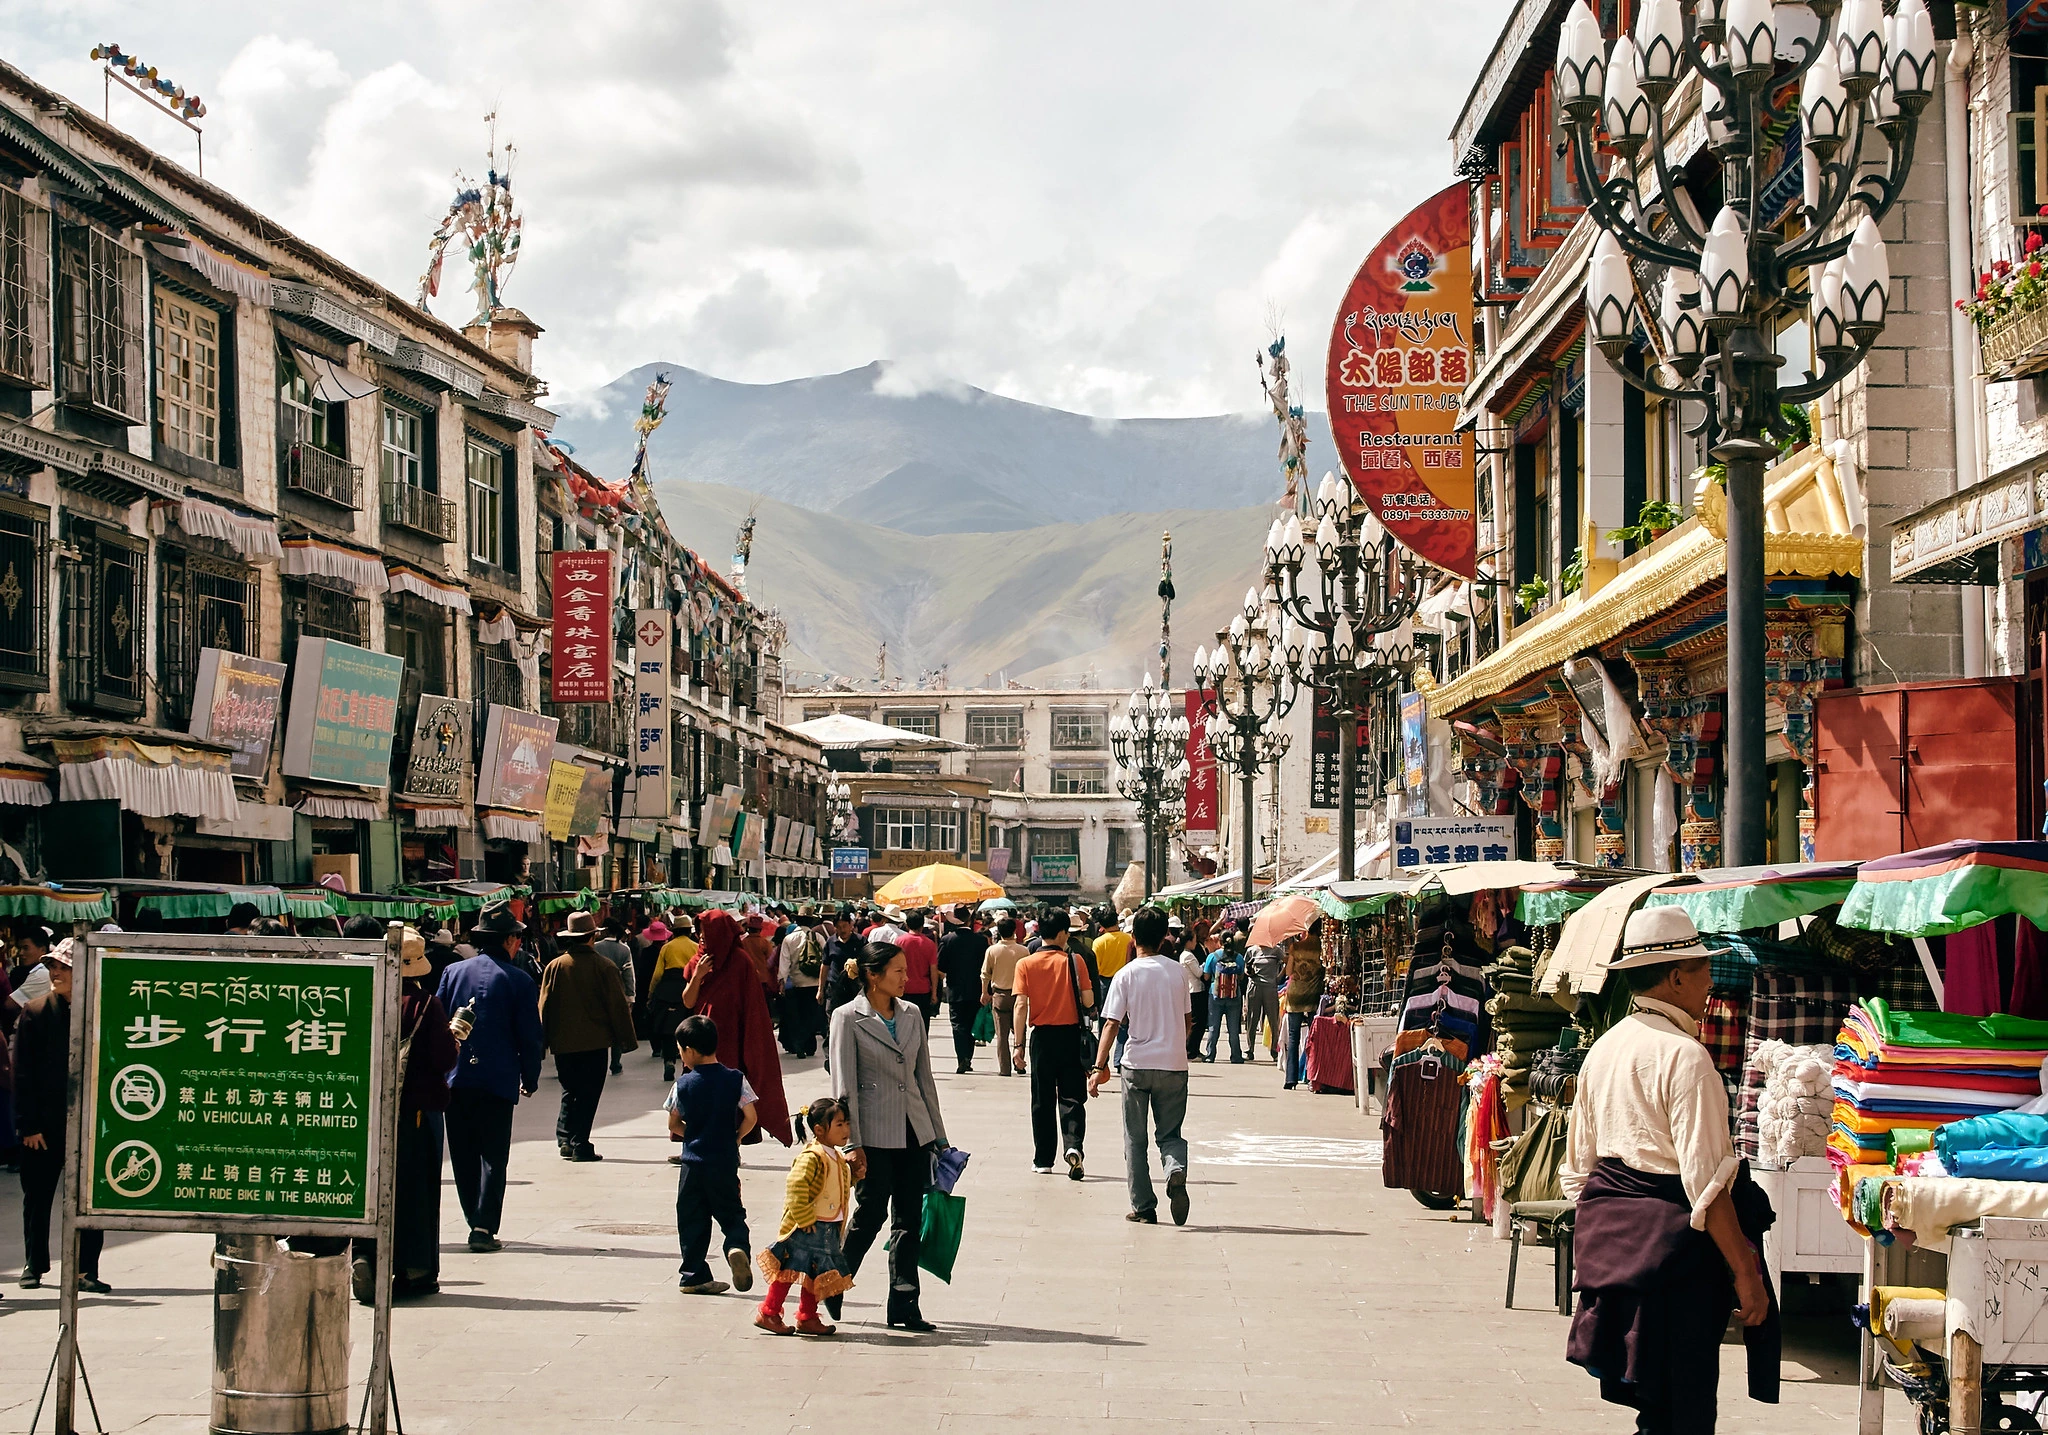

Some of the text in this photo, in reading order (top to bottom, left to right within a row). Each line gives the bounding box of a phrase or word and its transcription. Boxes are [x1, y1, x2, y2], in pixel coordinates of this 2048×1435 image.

[1343, 350, 1468, 385] 太陽部落
[1343, 393, 1461, 412] THE SUN TRIB
[1361, 432, 1462, 446] Restaurant
[835, 855, 867, 864] 安全通道
[124, 1015, 347, 1056] 步行街
[179, 1087, 358, 1110] 禁止机动车辆出入
[178, 1110, 358, 1128] NO VEHICULAR A PERMITED
[177, 1163, 355, 1186] 禁止骑自行车出入
[174, 1186, 353, 1205] DON'T RIDE BIKE IN THE BARKHOR
